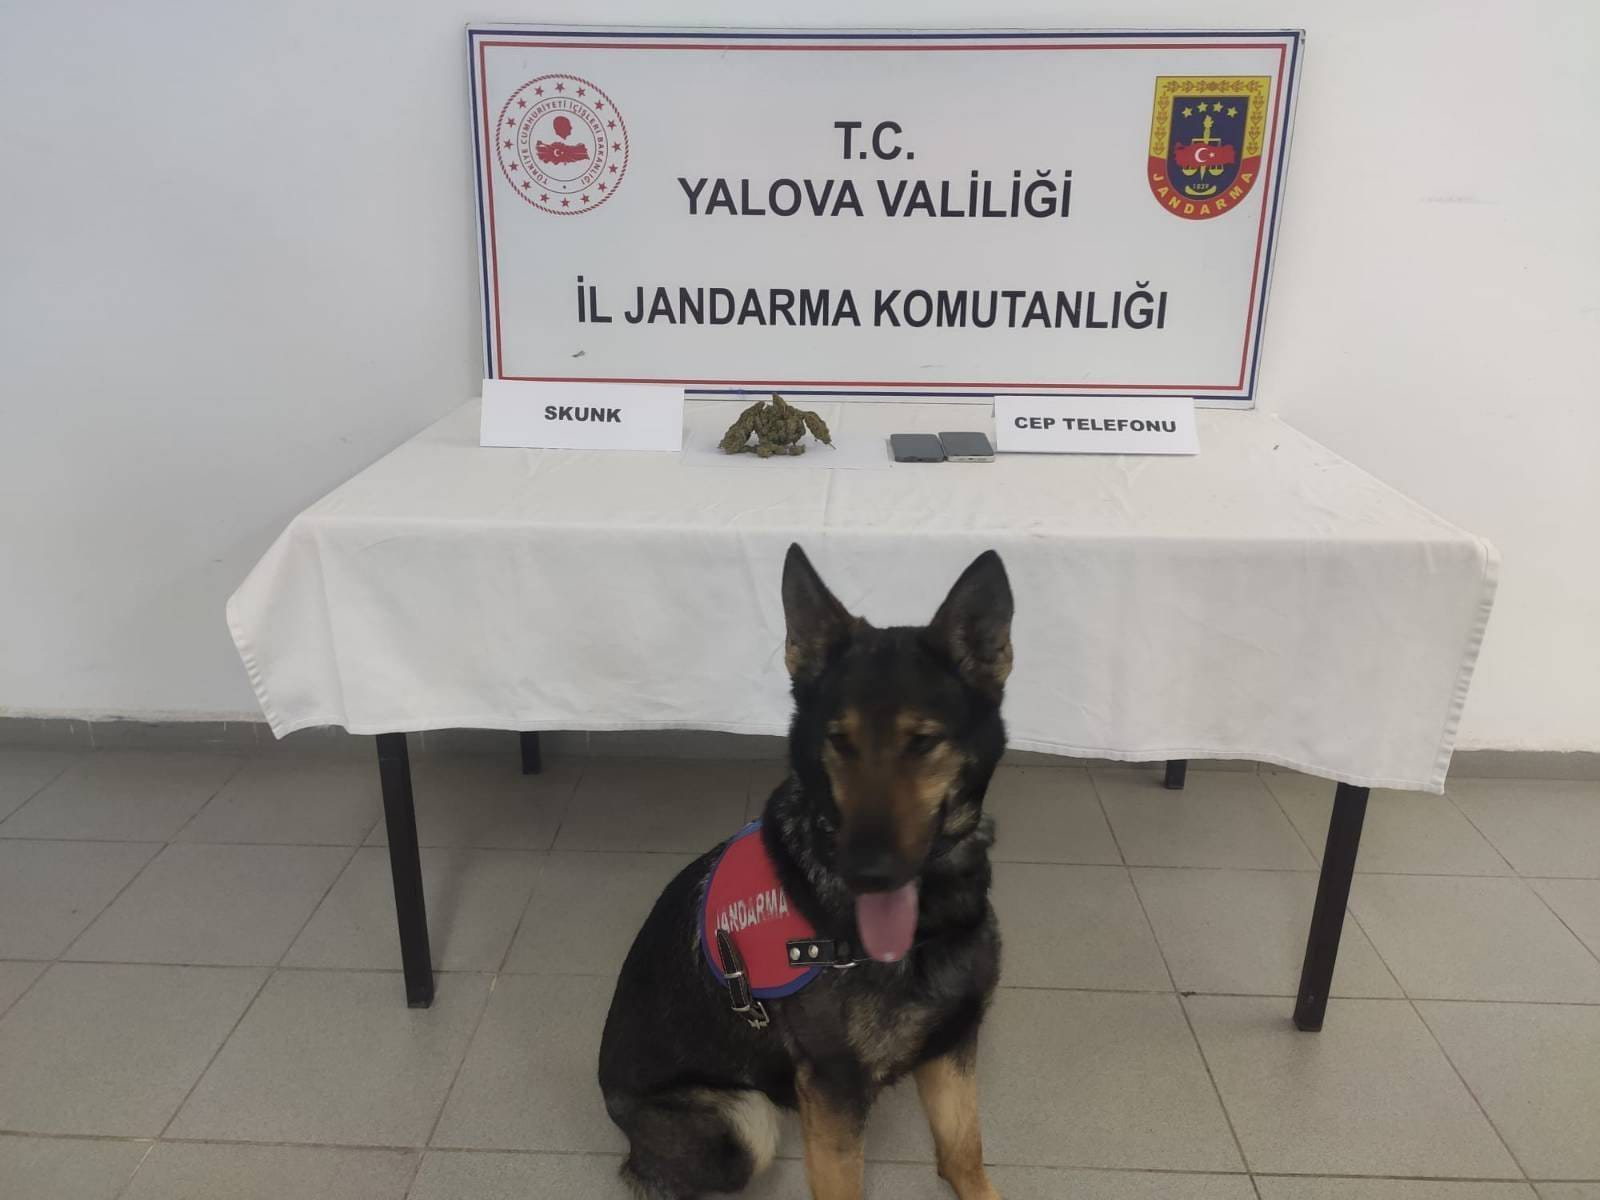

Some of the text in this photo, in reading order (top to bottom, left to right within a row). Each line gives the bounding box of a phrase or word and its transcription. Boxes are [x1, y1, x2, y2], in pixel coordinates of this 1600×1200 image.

[522, 100, 566, 145] CUMHURİYETİ
[568, 101, 603, 135] İÇİŞLERİ
[835, 121, 915, 160] T.C.
[522, 147, 549, 185] TÜRKİYE
[678, 169, 1073, 218] YALOVA VALİLİĞİ
[1152, 172, 1253, 216] JANDARMA
[577, 275, 1168, 330] İL JANDARMA KOMUTANLIĞI
[544, 405, 622, 423] SKUNK
[1014, 416, 1177, 433] CEP TELEFONU
[714, 888, 790, 936] JANDARMA
